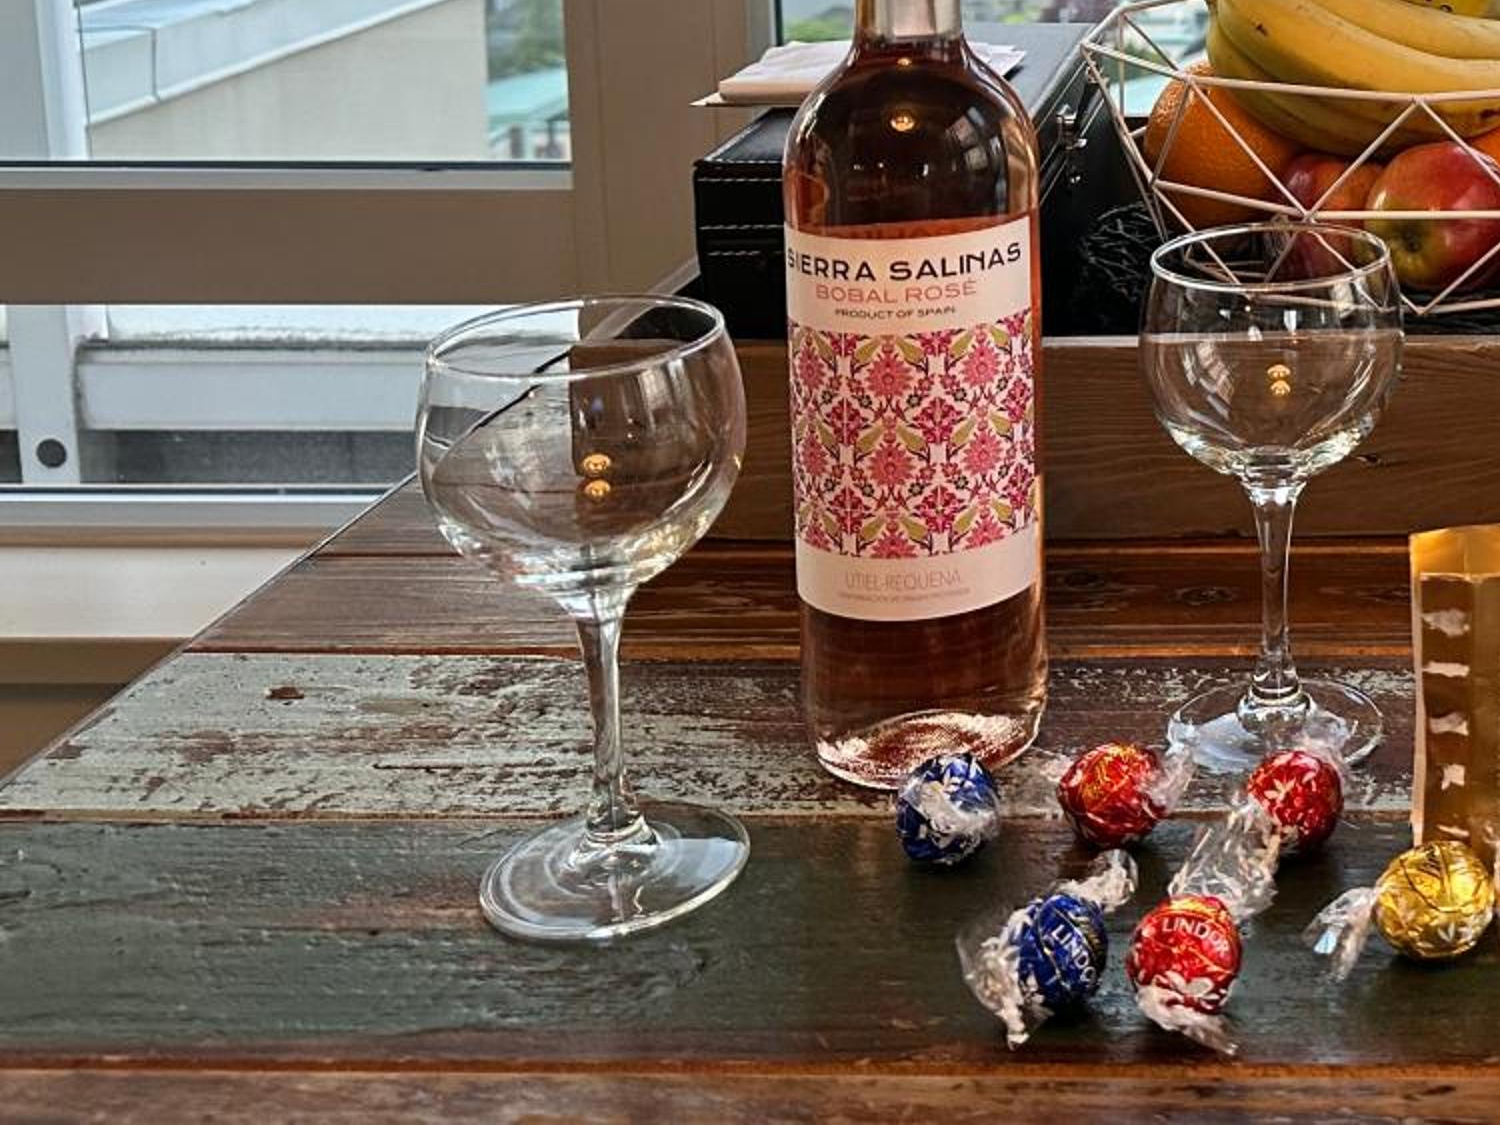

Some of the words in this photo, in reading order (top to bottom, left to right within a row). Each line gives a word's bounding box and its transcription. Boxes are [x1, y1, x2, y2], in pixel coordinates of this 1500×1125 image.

[787, 247, 876, 281] SIERRA
[889, 242, 1022, 281] SALINAS
[815, 284, 898, 305] BOBAL
[904, 278, 977, 303] ROSÉ
[834, 308, 893, 320] PRODUCT
[896, 308, 914, 320] OF
[917, 305, 956, 318] SPAIN
[1051, 923, 1097, 983] LINDO
[1162, 917, 1230, 956] LINDOR
